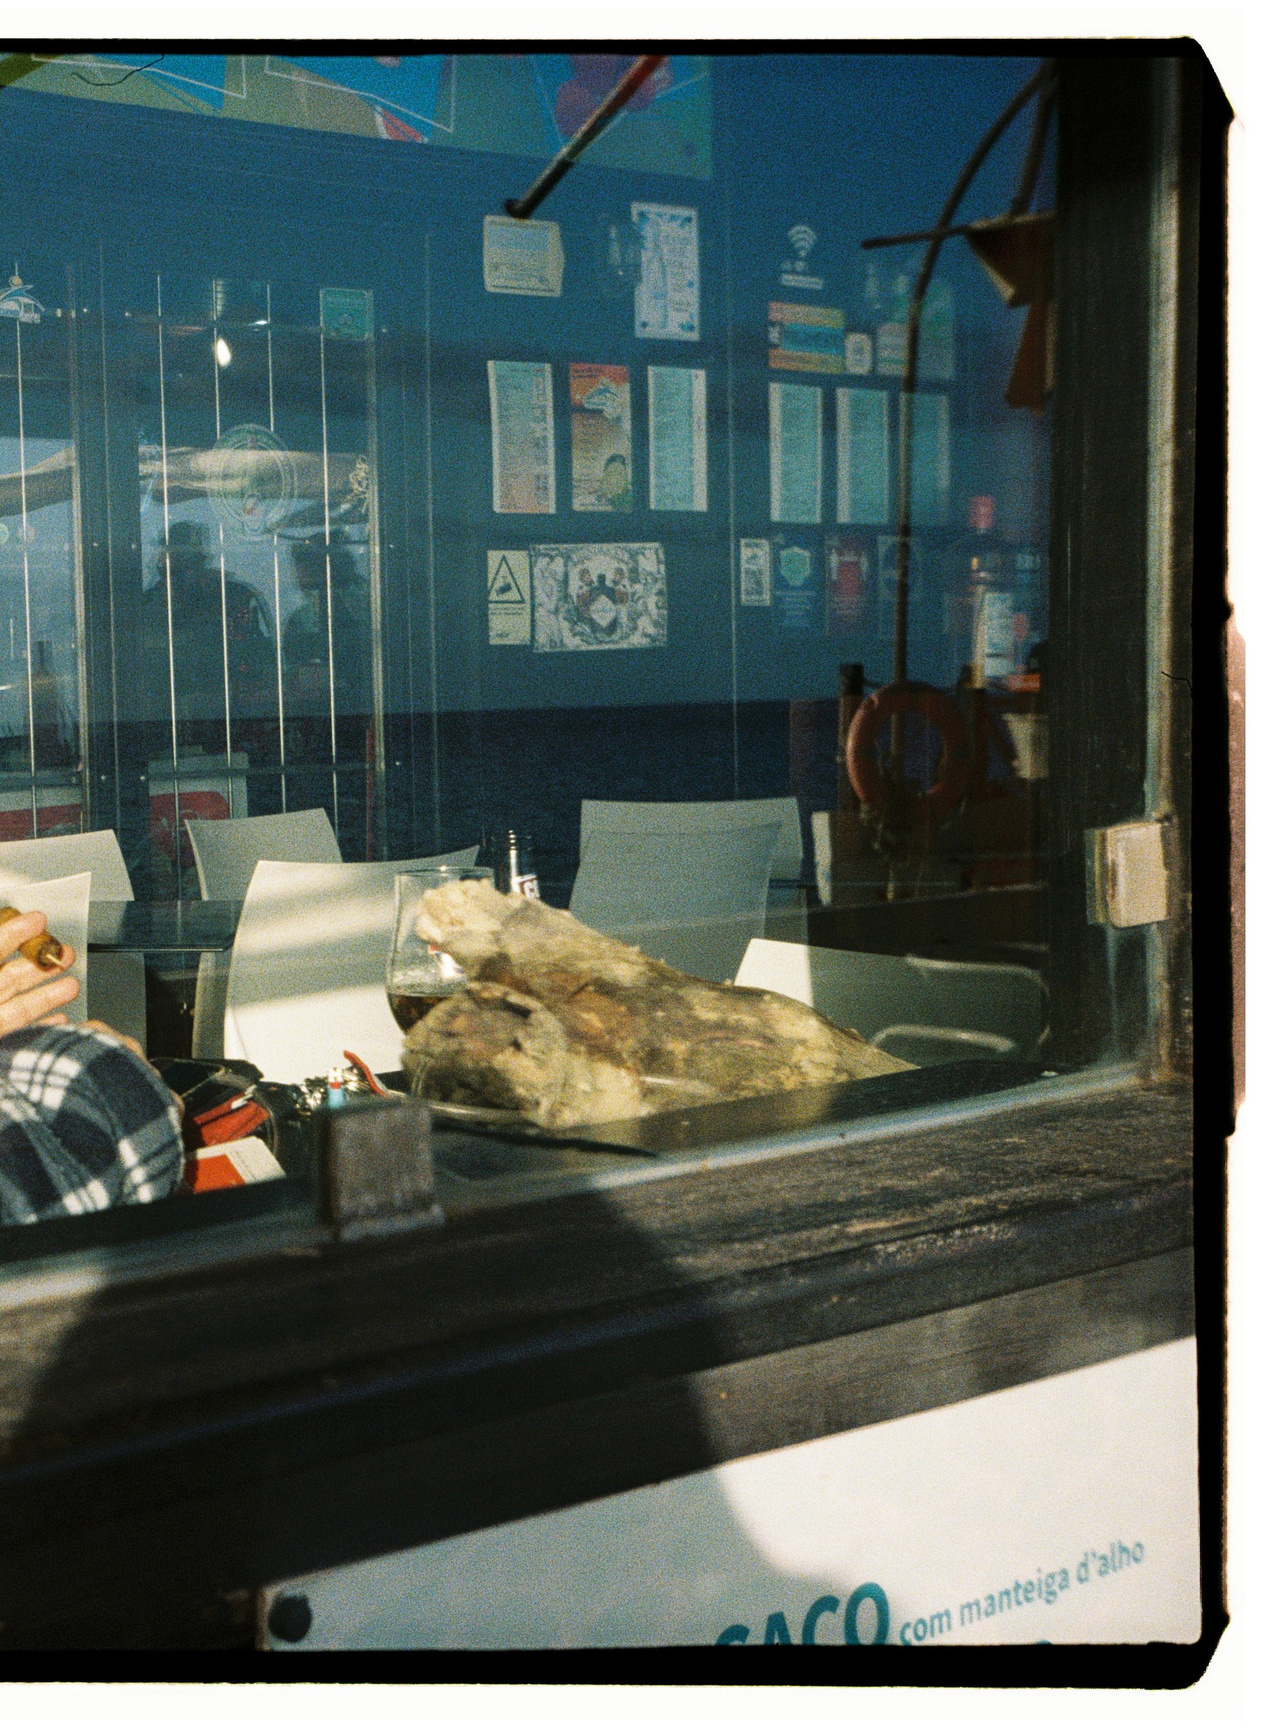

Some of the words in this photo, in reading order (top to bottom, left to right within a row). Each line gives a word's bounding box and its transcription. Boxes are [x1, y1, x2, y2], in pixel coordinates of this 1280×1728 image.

[899, 1606, 952, 1646] com
[960, 1565, 1070, 1627] manteiga
[1076, 1540, 1145, 1584] d'alho
